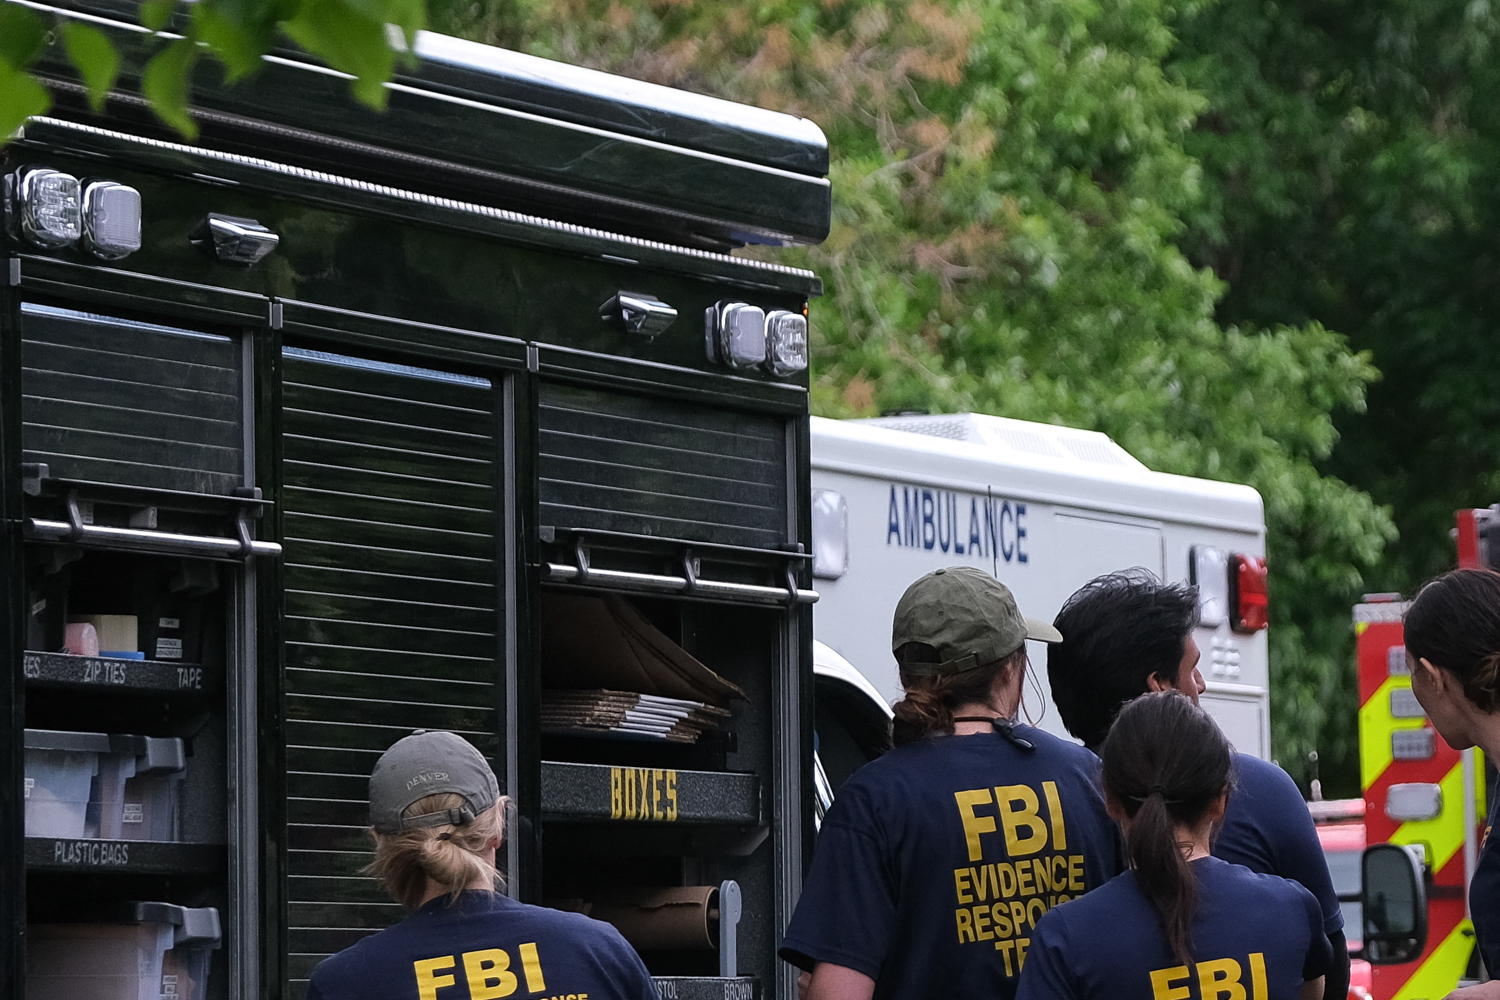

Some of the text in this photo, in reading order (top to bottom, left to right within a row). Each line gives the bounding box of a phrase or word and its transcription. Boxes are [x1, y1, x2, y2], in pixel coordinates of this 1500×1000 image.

[887, 484, 1028, 563] AMBULANCE
[84, 661, 127, 685] ZIP TIES
[177, 668, 202, 690] TAPE
[406, 772, 450, 791] DENVER
[611, 767, 678, 822] BOXES
[954, 780, 1067, 862] FBI
[54, 842, 129, 866] PLASTIC BAGS
[954, 855, 1085, 905] EVIDENCE
[724, 982, 753, 1000] BROWN
